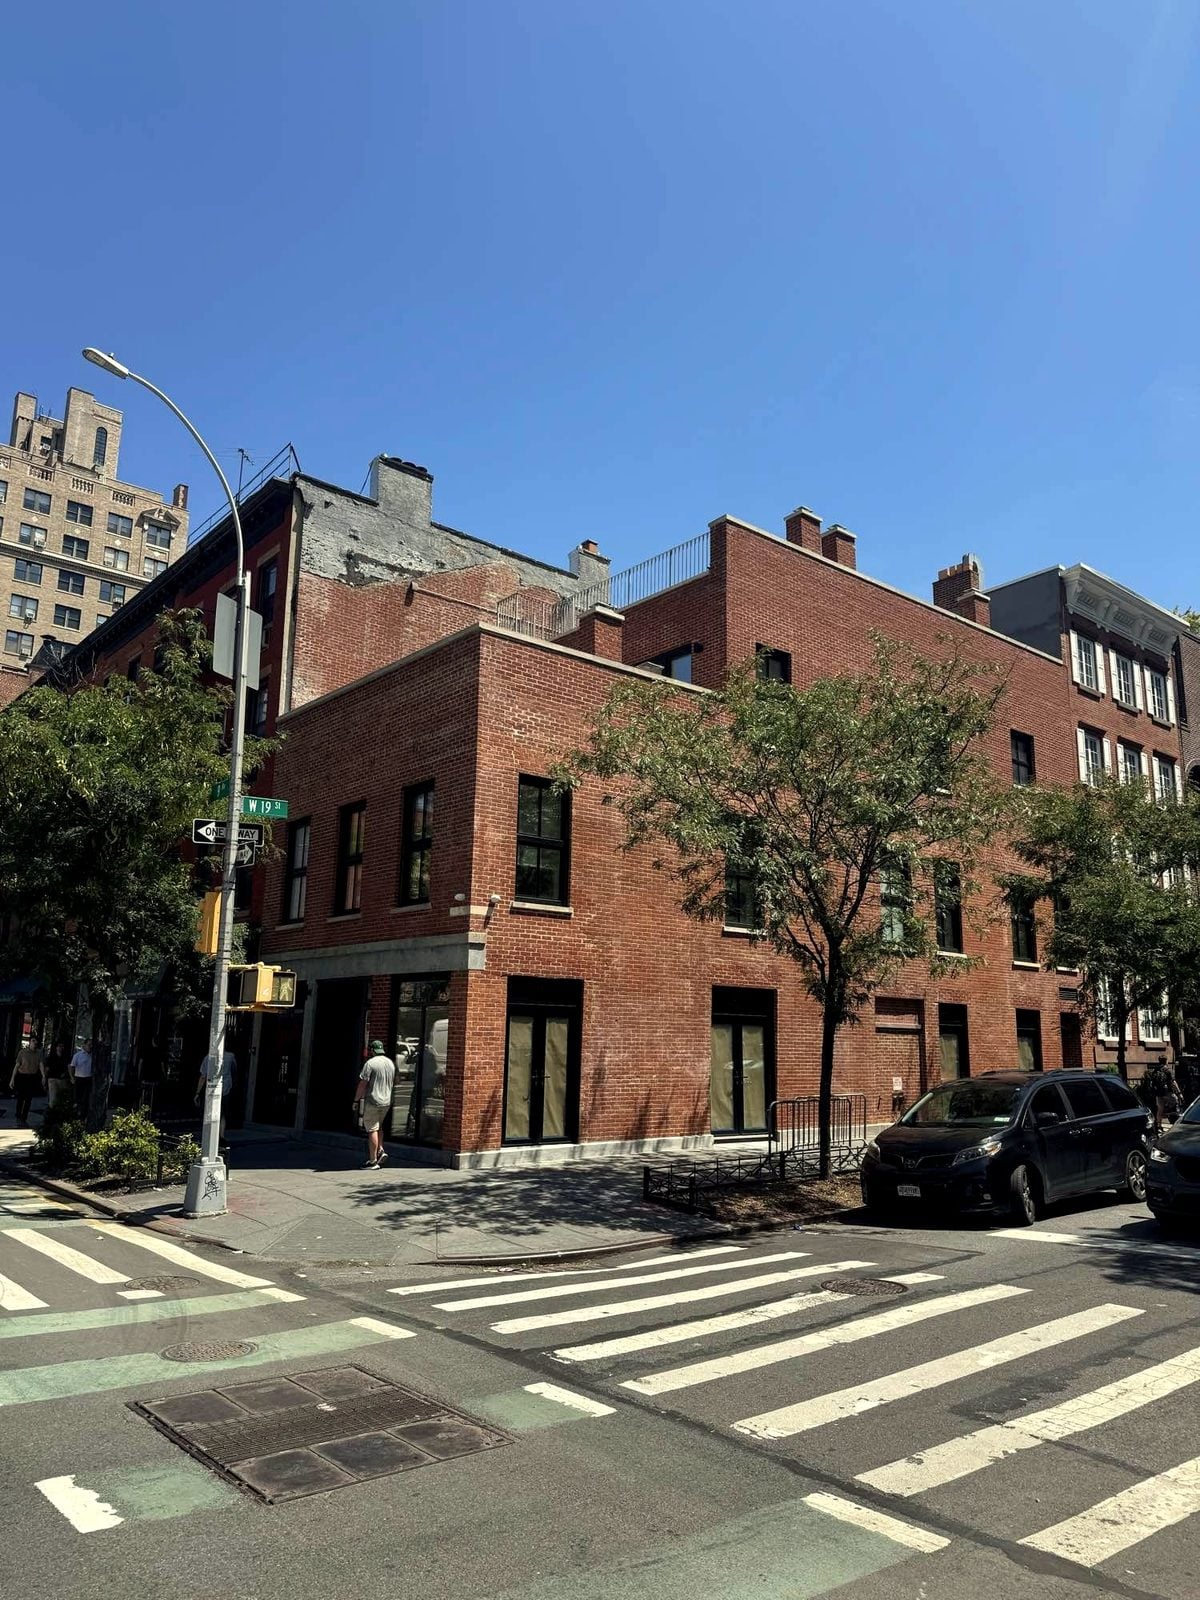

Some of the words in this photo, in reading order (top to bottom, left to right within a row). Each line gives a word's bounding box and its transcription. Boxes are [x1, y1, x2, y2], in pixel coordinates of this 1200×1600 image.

[249, 799, 258, 812] W
[261, 801, 271, 813] 19
[205, 826, 225, 837] ONE
